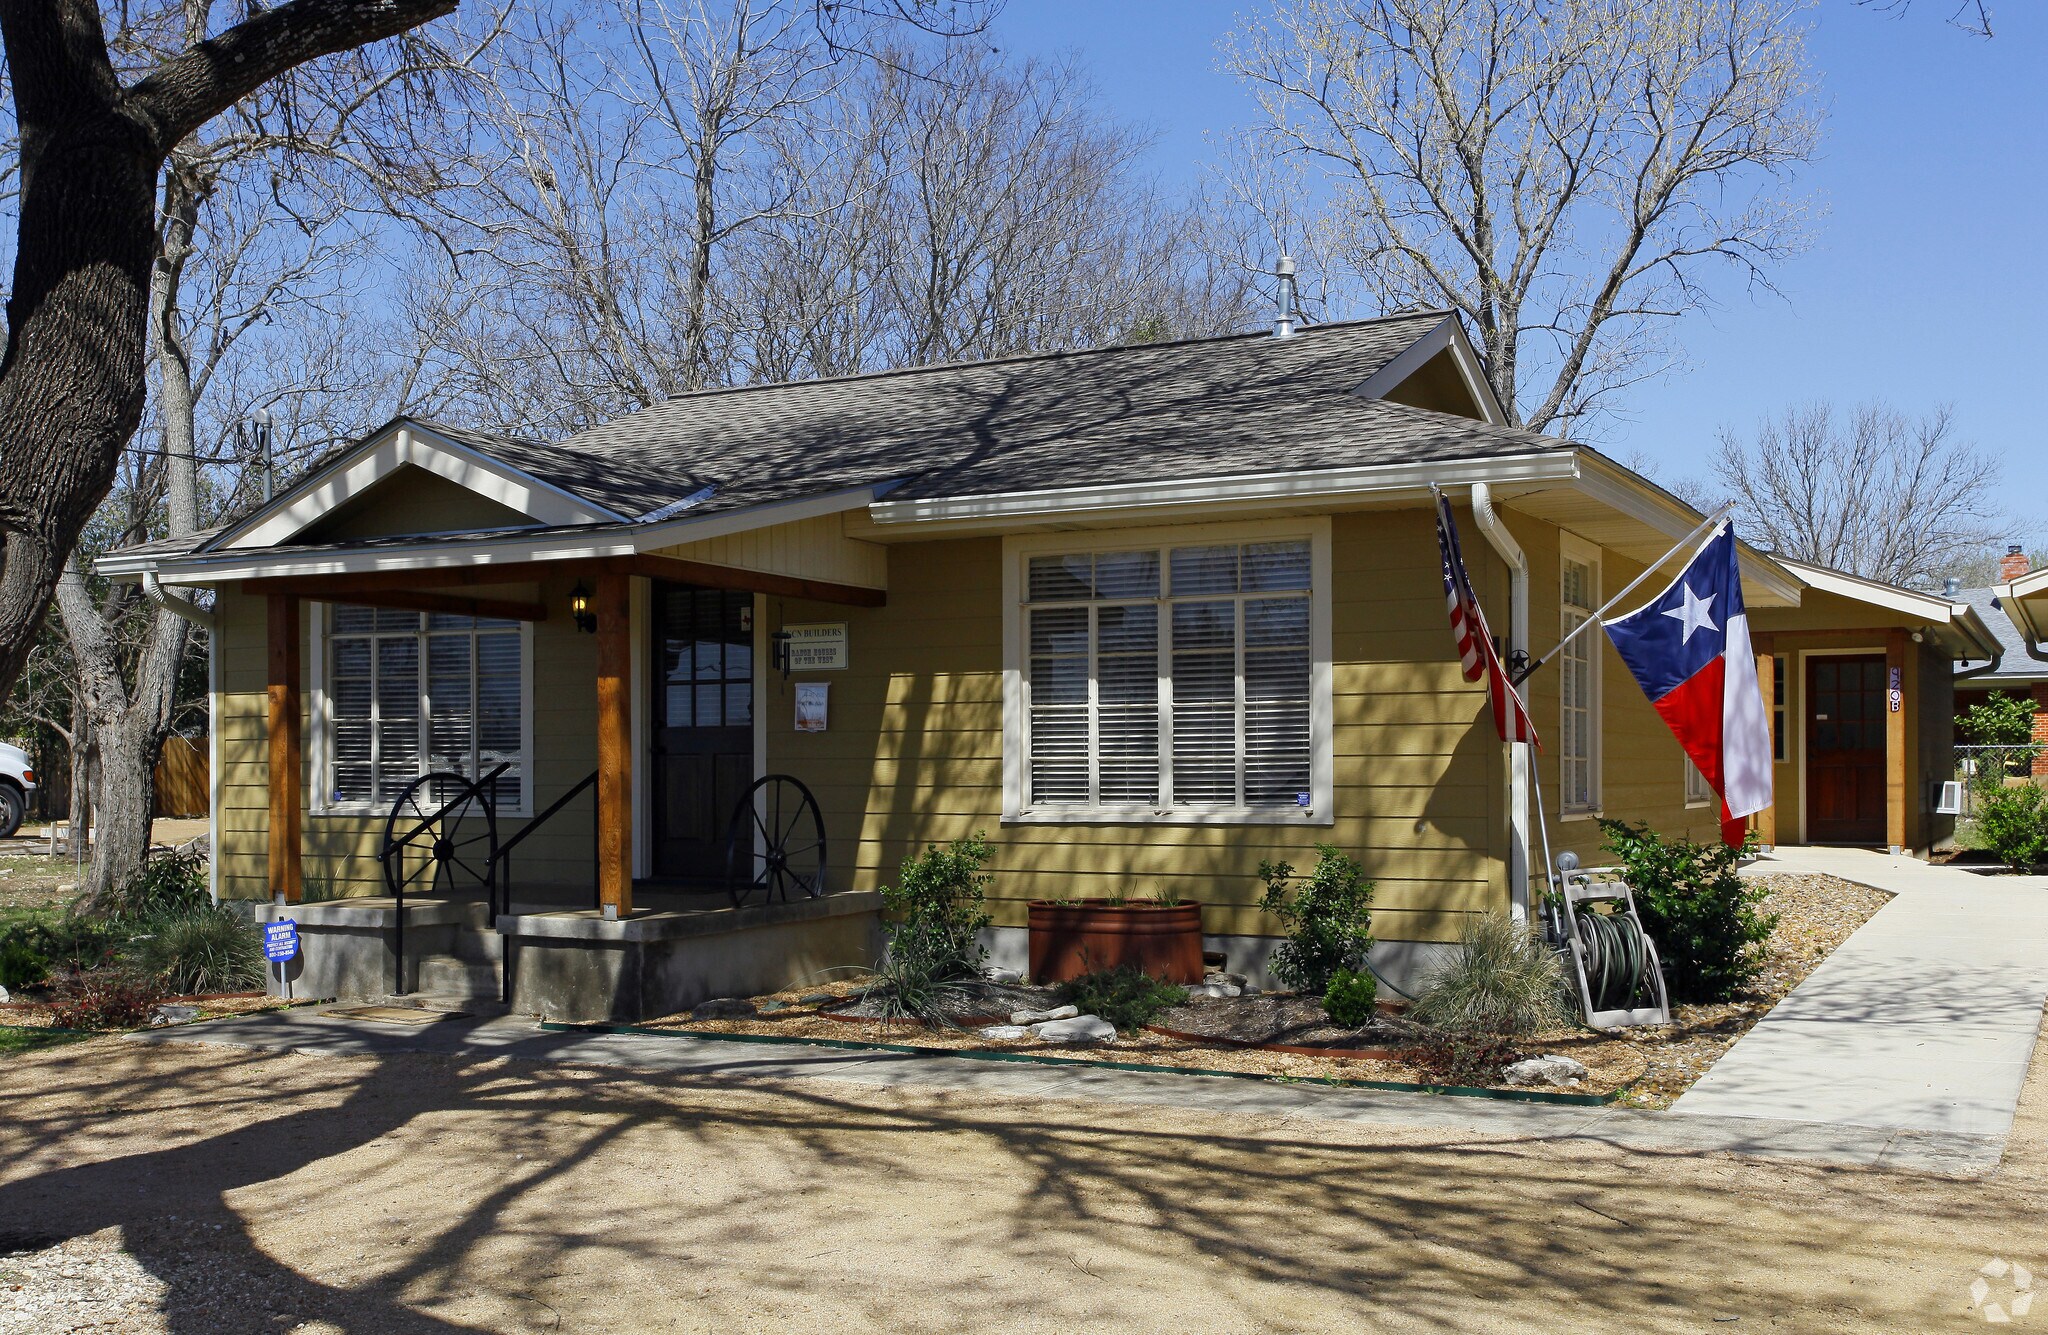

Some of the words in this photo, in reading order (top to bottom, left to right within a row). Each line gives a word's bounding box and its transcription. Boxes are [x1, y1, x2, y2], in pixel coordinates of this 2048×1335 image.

[804, 628, 842, 637] BUILDERS
[814, 648, 836, 656] HOUSES
[1890, 667, 1900, 712] 920B
[268, 924, 294, 934] WARNING
[271, 932, 291, 941] ALARM
